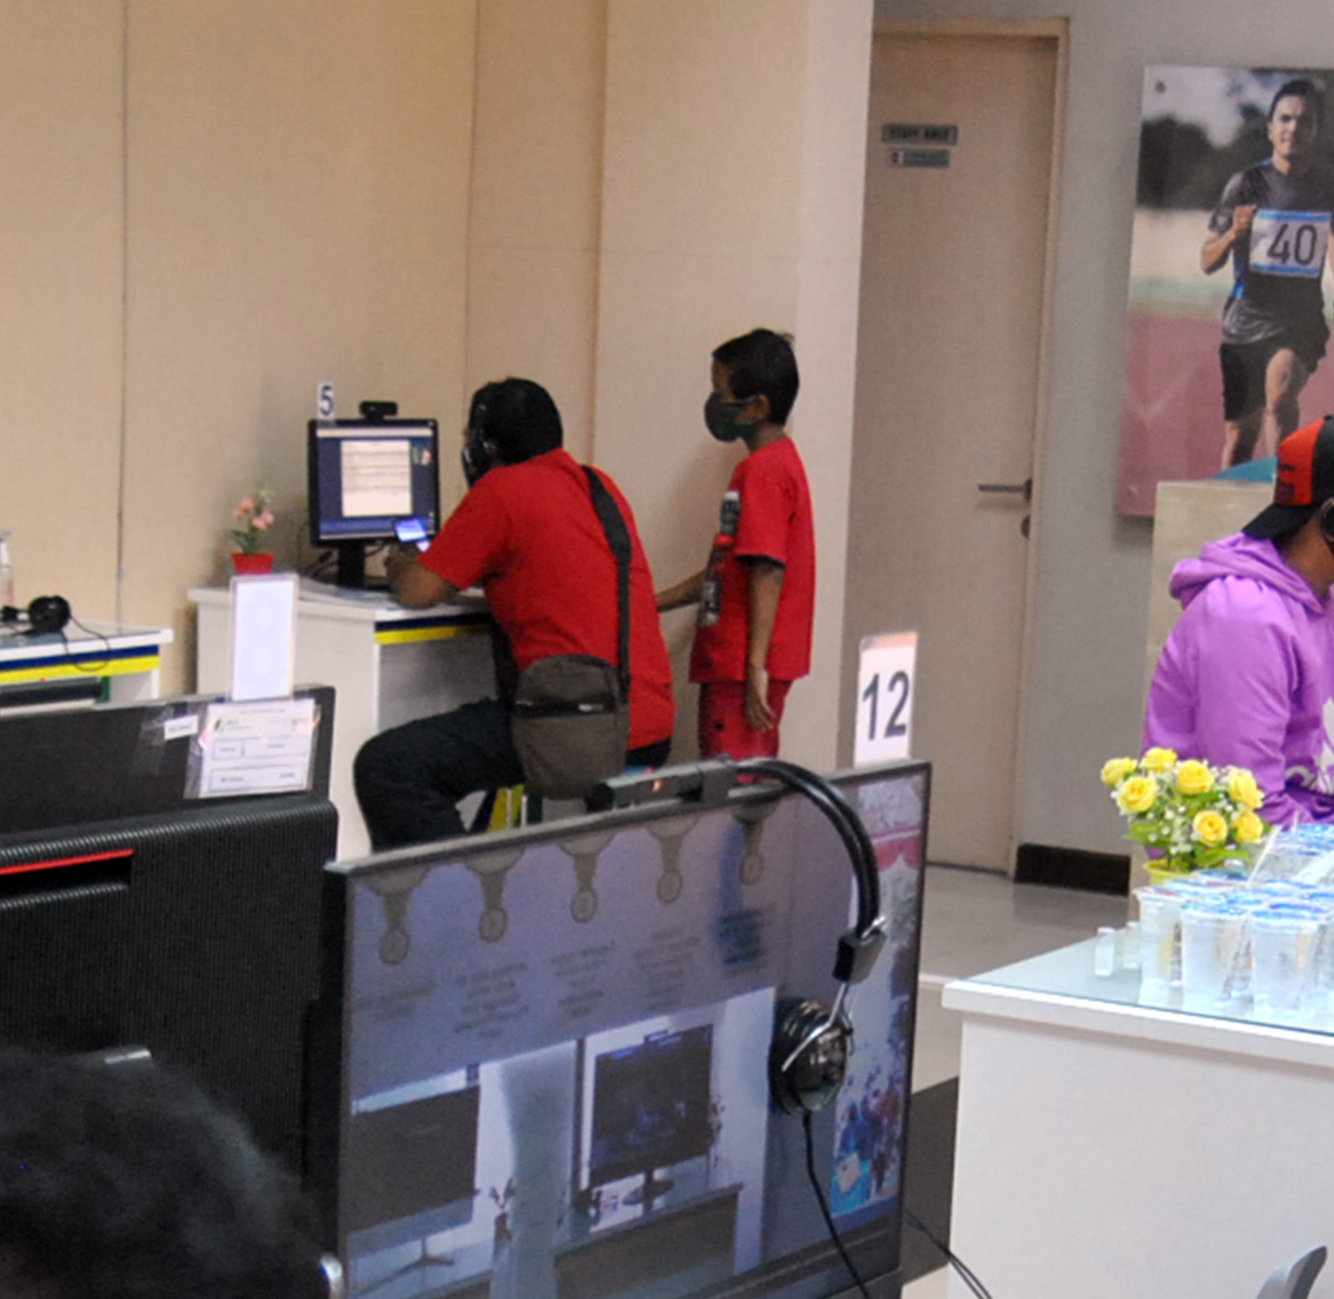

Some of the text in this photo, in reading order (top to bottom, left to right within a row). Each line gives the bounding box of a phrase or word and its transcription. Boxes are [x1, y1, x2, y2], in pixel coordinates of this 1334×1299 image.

[1267, 223, 1317, 265] 40
[320, 385, 333, 416] 5
[862, 670, 910, 741] 12
